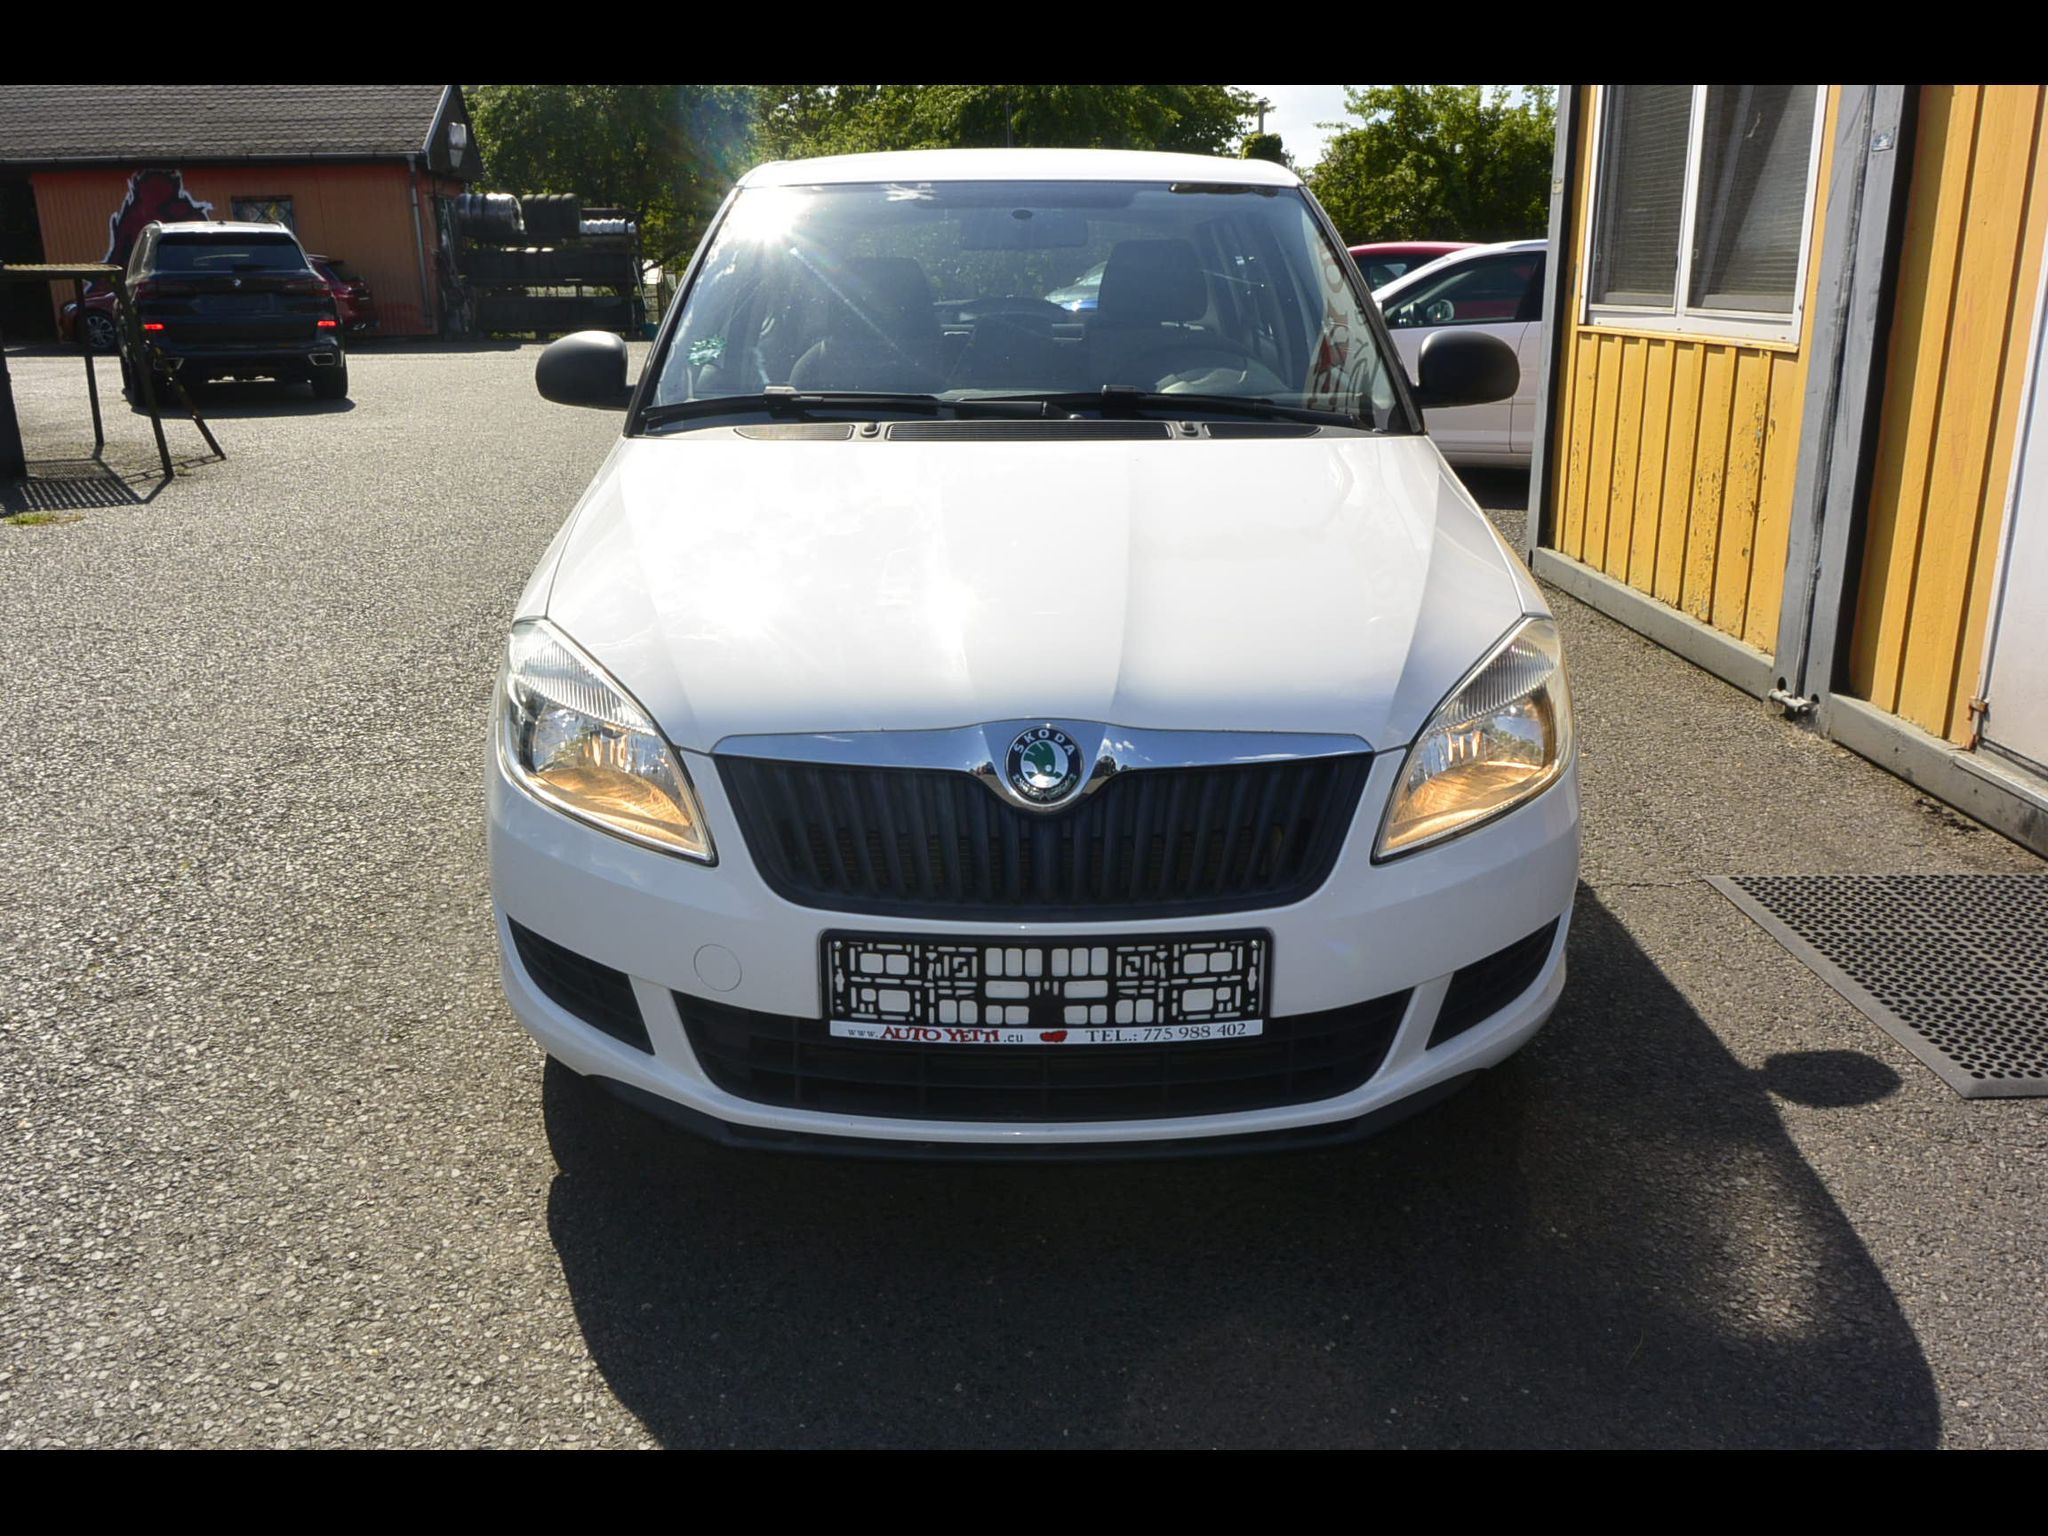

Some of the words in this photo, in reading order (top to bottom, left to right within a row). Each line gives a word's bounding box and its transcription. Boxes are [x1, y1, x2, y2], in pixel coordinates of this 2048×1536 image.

[1085, 1029, 1138, 1042] TEL.:
[1143, 1028, 1173, 1041] 775
[1178, 1025, 1211, 1038] 988
[1217, 1023, 1246, 1036] 402
